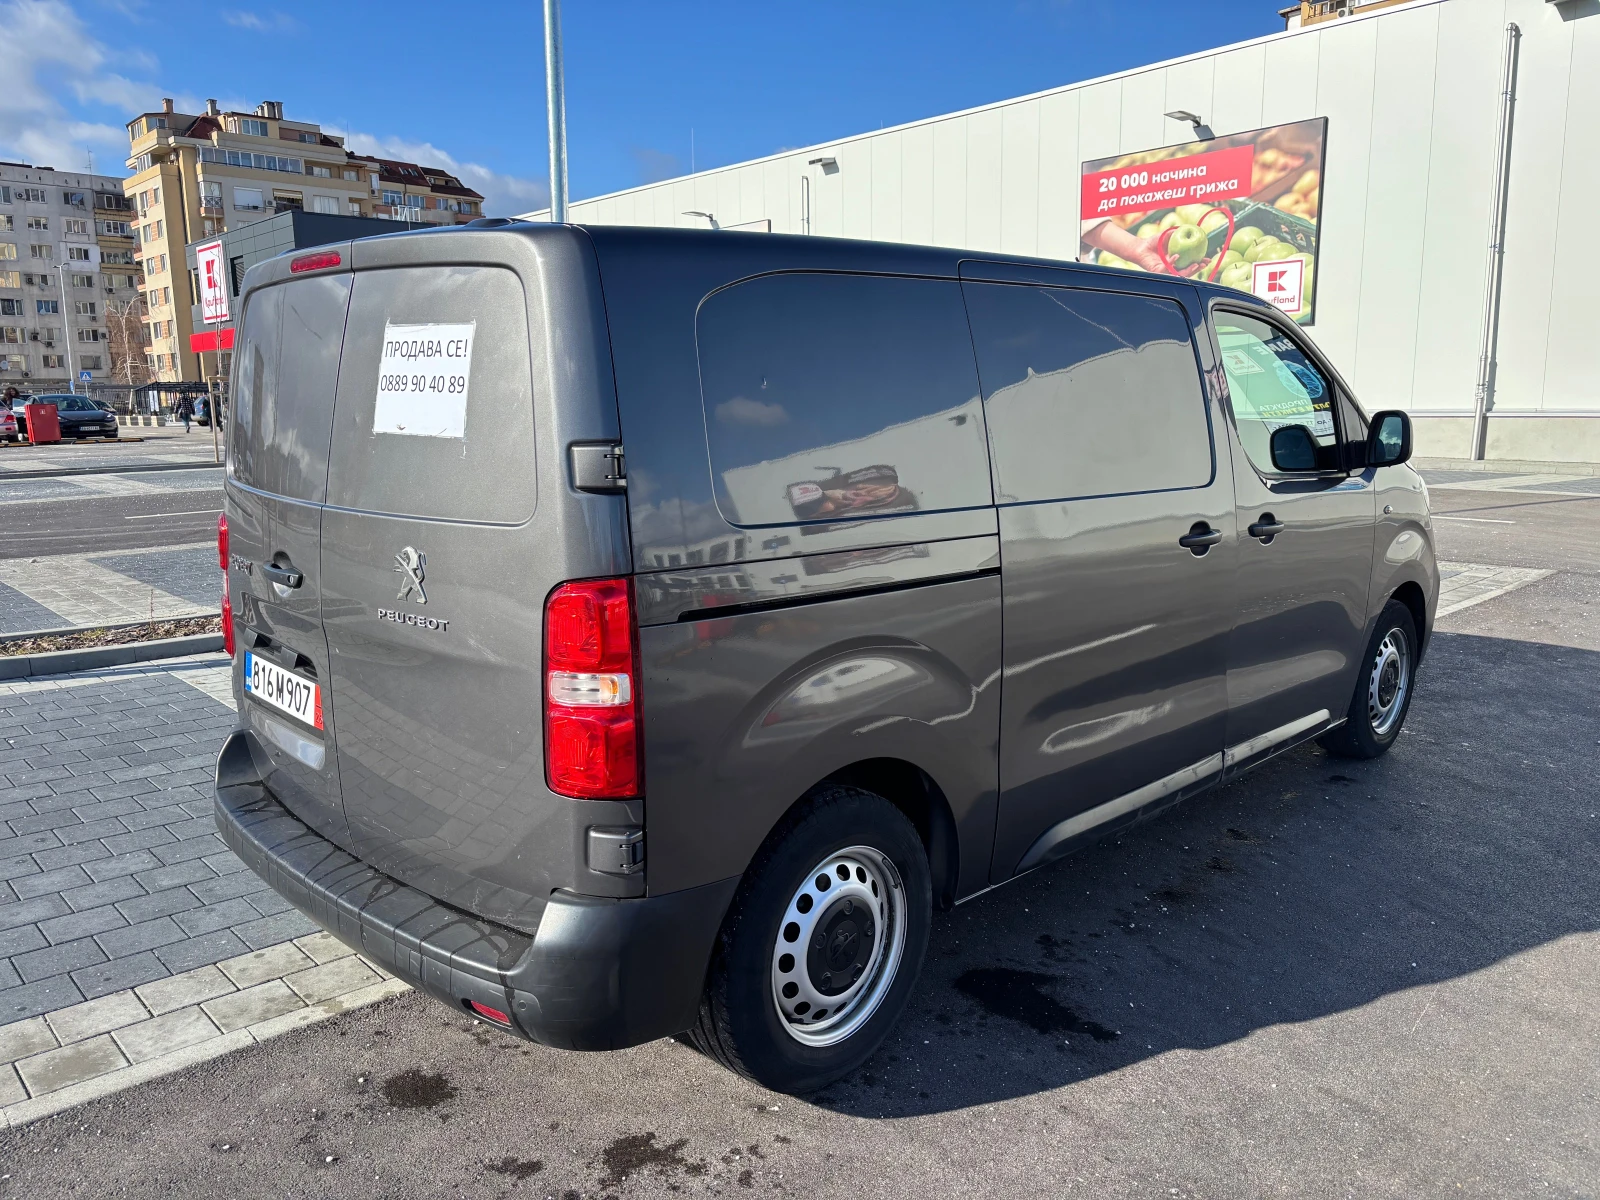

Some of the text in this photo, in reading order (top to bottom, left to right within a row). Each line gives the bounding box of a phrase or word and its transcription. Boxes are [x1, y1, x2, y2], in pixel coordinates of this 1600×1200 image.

[1098, 165, 1207, 193] 20 000 начина
[1097, 178, 1239, 212] да покажеш грижа
[1270, 294, 1296, 304] fland
[385, 339, 468, 361] ПРОДАВА СЕ!
[380, 374, 465, 393] 0889 90 40 89
[378, 608, 450, 632] PEUGEOT
[253, 661, 310, 715] 816M907
